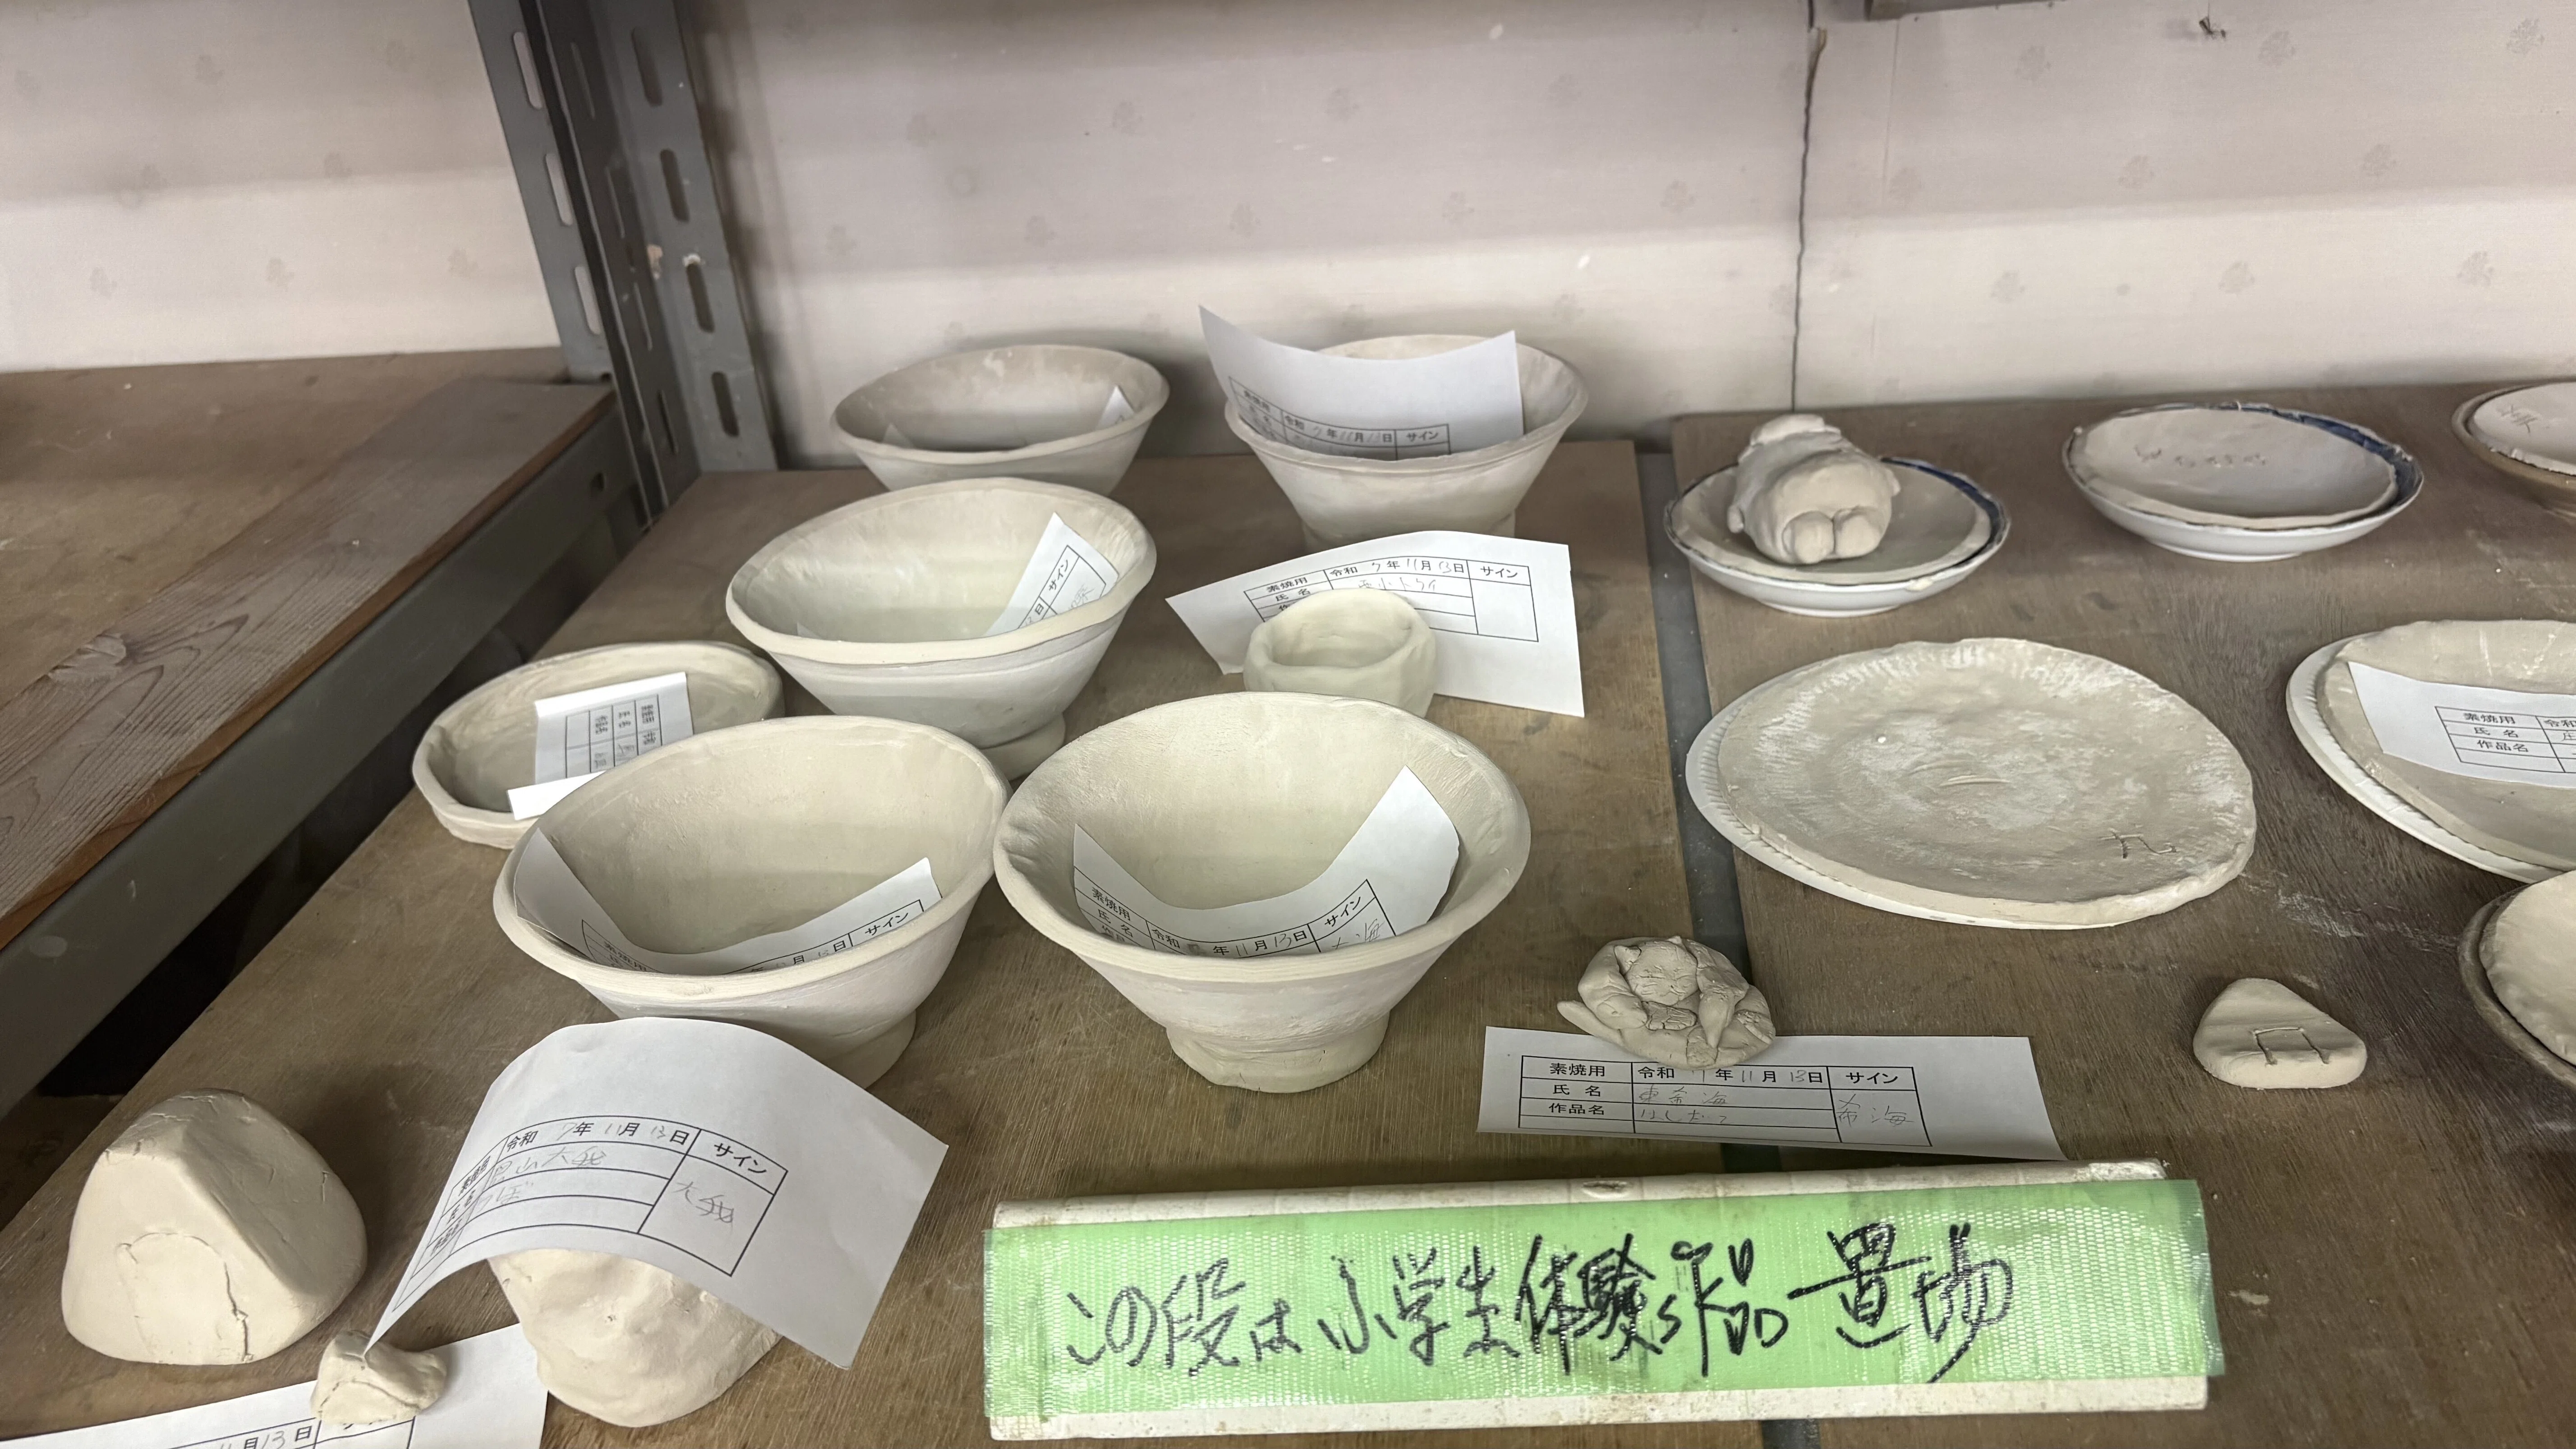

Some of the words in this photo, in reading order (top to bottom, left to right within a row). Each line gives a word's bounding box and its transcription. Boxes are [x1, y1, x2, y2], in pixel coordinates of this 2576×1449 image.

[1406, 431, 1439, 442] サイン
[1049, 559, 1068, 591] サイン
[1480, 566, 1518, 578] サイン
[2477, 740, 2529, 752] 作品名
[1098, 909, 1133, 937] 氏名
[1324, 897, 1361, 927] サイン
[865, 912, 908, 935] サイン
[1550, 1063, 1605, 1077] 素焼用
[1846, 1072, 1898, 1085] サイン
[1553, 1084, 1601, 1097] 氏名
[1549, 1102, 1605, 1115] 作品名
[714, 1143, 767, 1173] サイン
